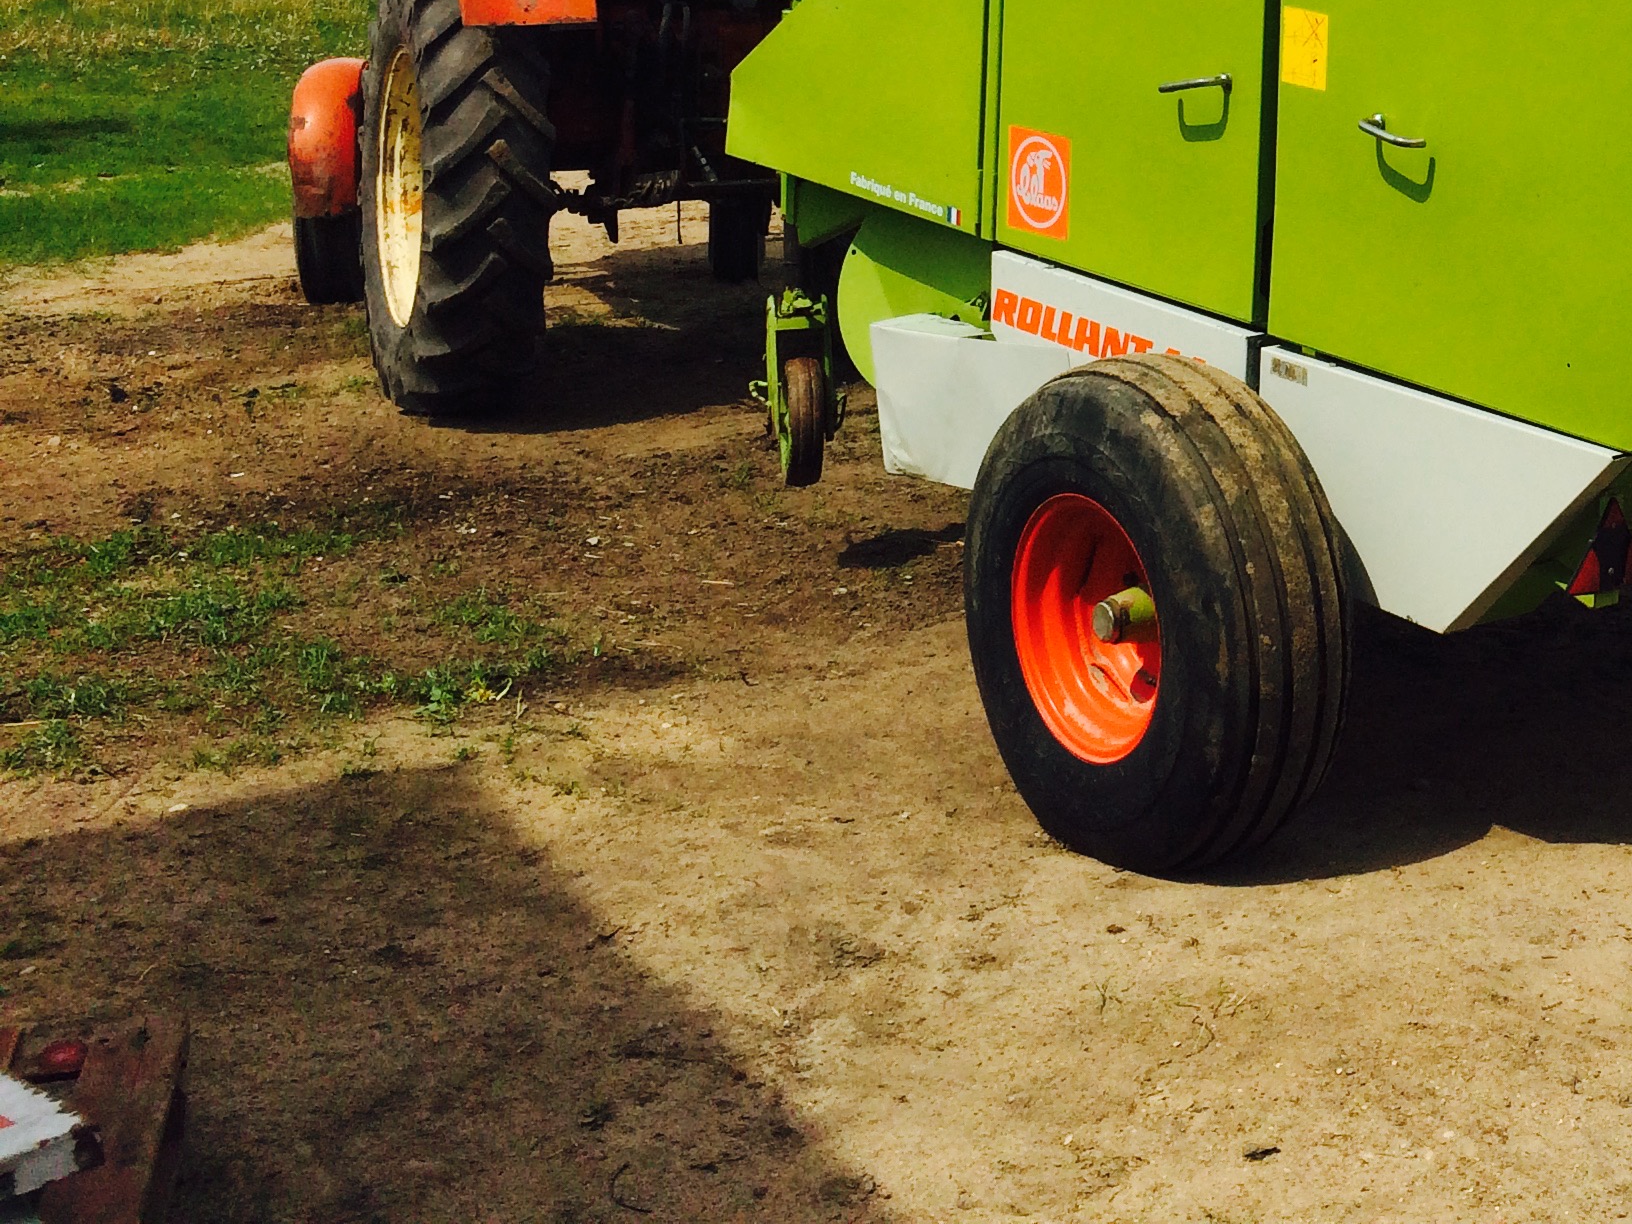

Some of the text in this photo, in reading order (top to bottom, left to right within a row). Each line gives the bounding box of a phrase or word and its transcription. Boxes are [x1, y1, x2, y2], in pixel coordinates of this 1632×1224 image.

[849, 171, 944, 217] Fabriqué en France
[992, 288, 1154, 359] ROLLANT
